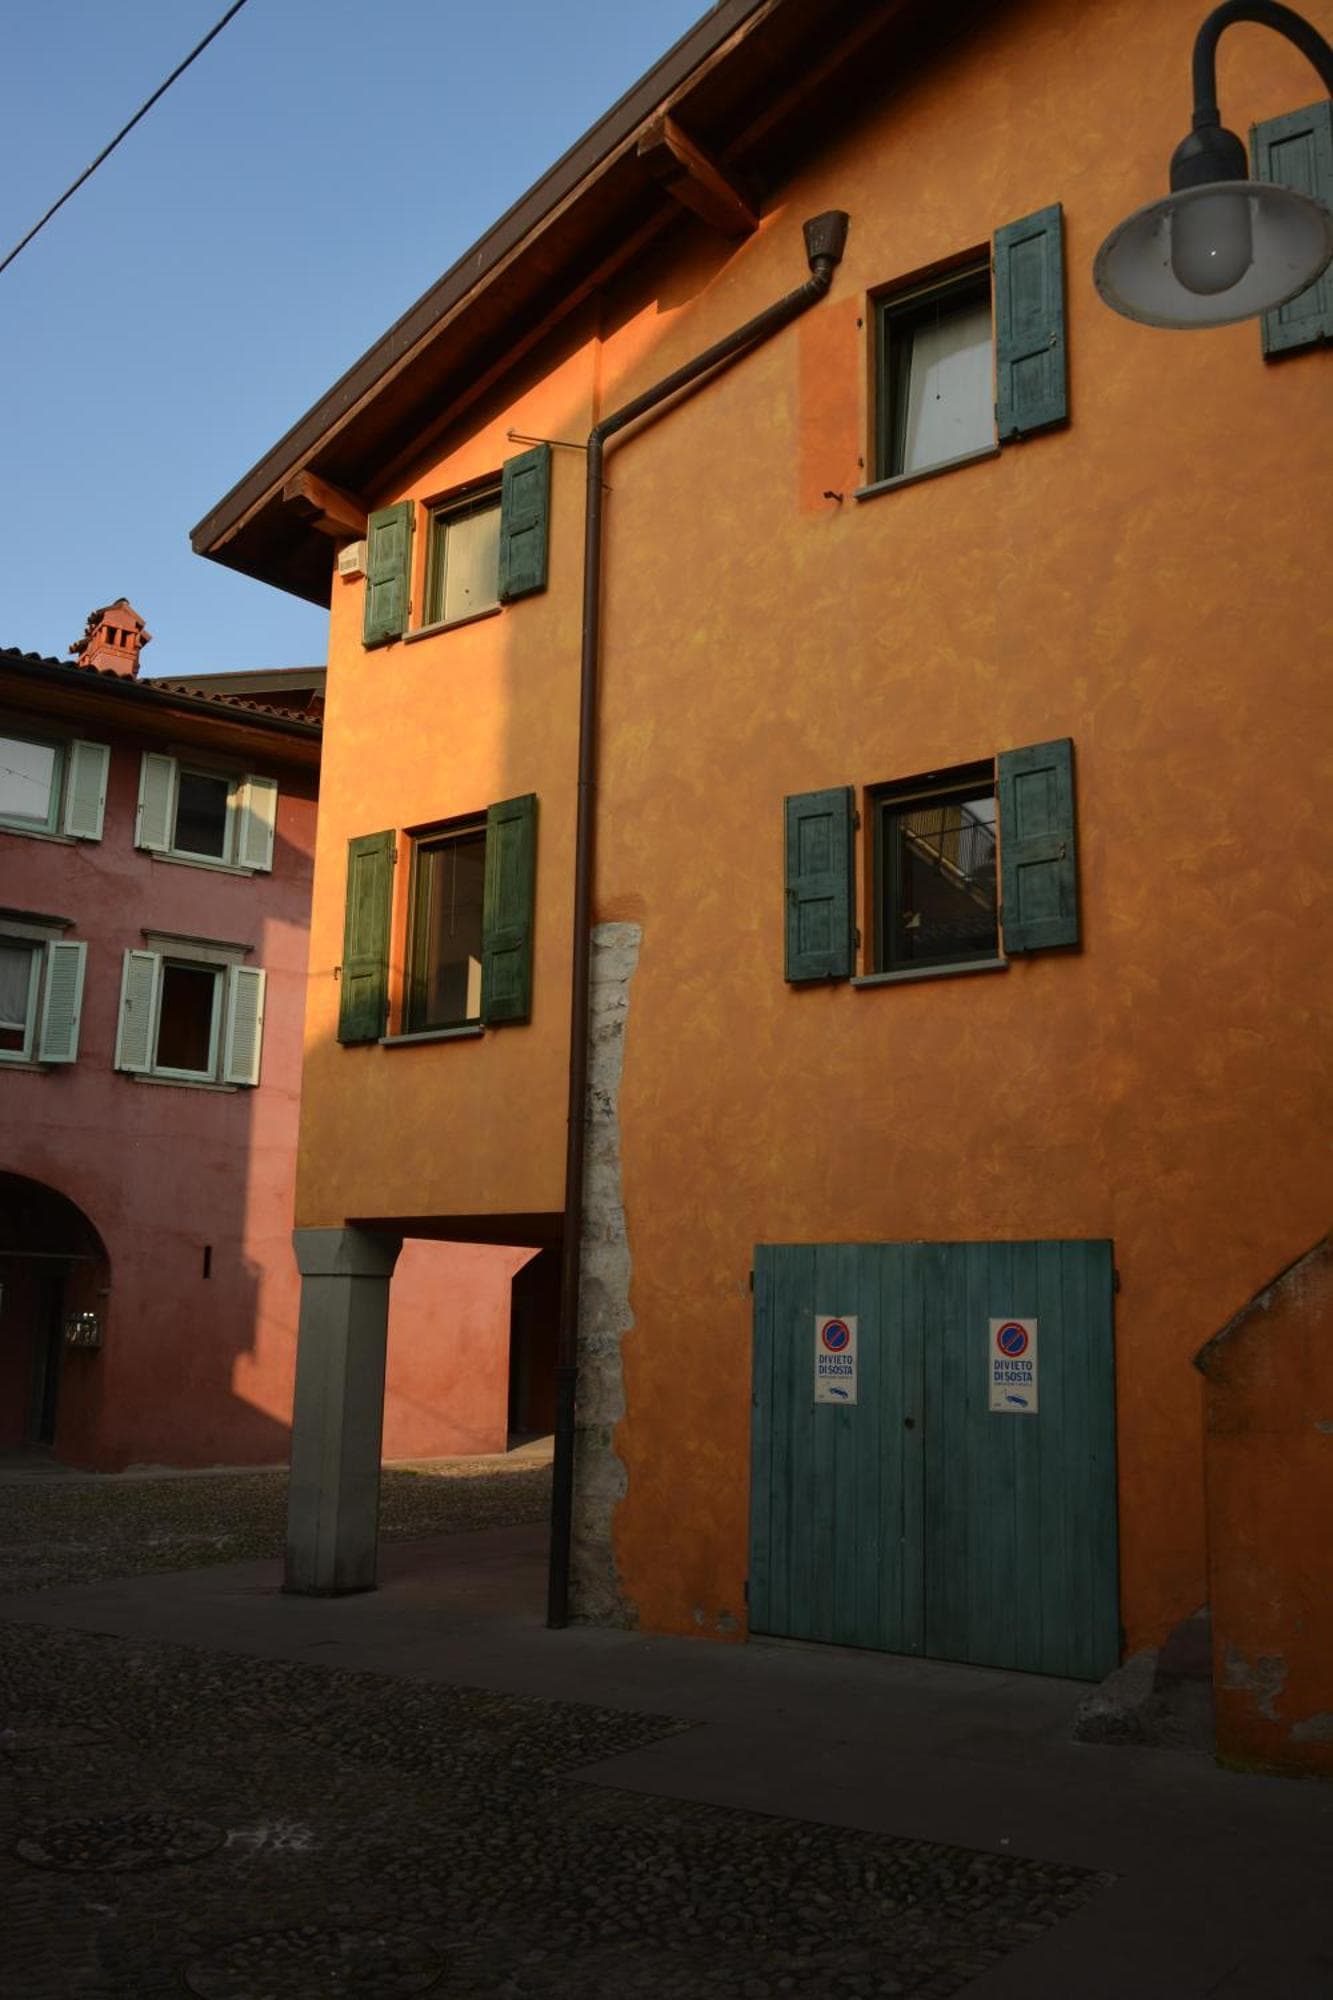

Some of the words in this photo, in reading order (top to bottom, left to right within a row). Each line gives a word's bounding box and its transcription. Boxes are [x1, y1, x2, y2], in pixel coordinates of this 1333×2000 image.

[819, 1355, 853, 1364] DIVIETO
[828, 1365, 853, 1375] SOSTA
[994, 1361, 1033, 1370] DIVIETO
[994, 1371, 1003, 1381] DI
[1004, 1371, 1033, 1381] SOSTA
